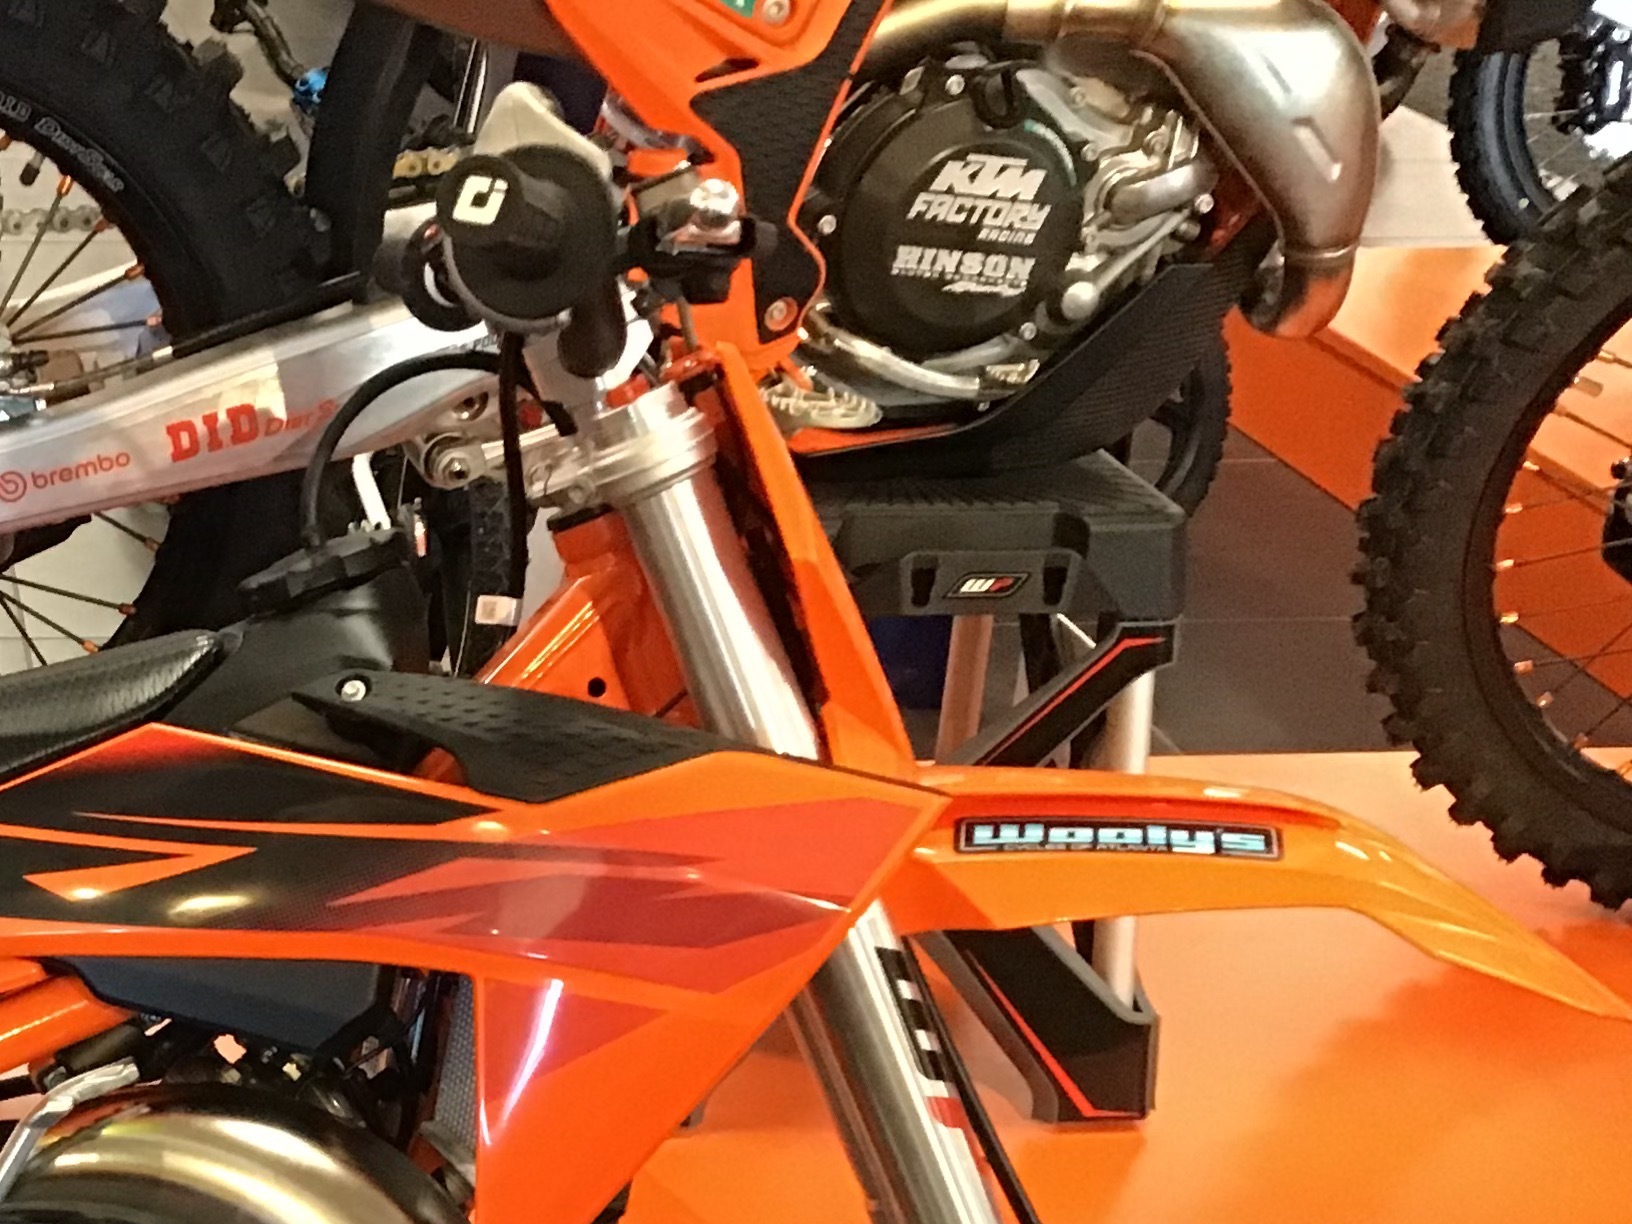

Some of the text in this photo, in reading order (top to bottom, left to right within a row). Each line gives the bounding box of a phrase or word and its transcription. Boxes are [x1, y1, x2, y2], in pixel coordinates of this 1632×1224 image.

[928, 153, 1048, 201] KTM
[905, 191, 1052, 231] FACTORY
[891, 245, 1036, 280] HINSON
[166, 403, 259, 462] DID
[31, 452, 131, 489] brembo
